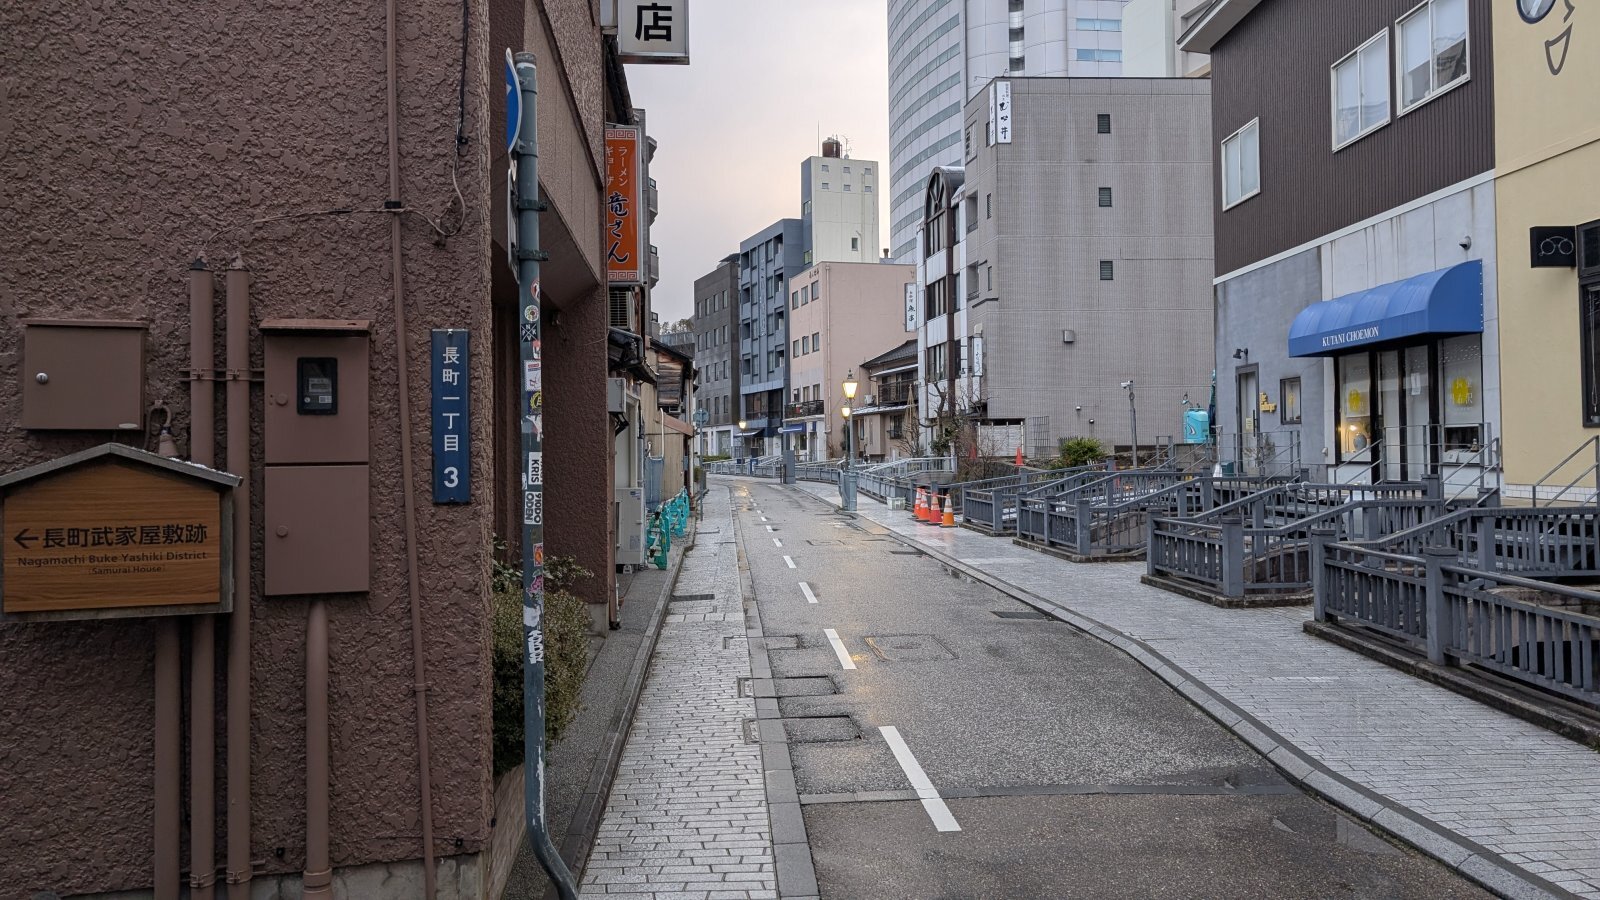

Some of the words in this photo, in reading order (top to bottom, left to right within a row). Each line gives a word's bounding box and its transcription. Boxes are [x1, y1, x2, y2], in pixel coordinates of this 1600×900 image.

[635, 3, 672, 42] 店
[618, 146, 628, 186] ラーメン
[607, 191, 629, 264] 竜さん
[1322, 333, 1345, 347] KUTANI
[1346, 326, 1379, 342] CHOEMON
[442, 346, 460, 452] 長町一丁目
[443, 466, 459, 488] 3
[531, 459, 540, 483] KRIS
[525, 492, 535, 521] ODEN
[42, 523, 208, 549] 長町武家屋敷跡
[17, 554, 85, 568] Nagamachi
[88, 554, 118, 564] Buke
[121, 552, 163, 563] Yashiki
[166, 550, 208, 561] District
